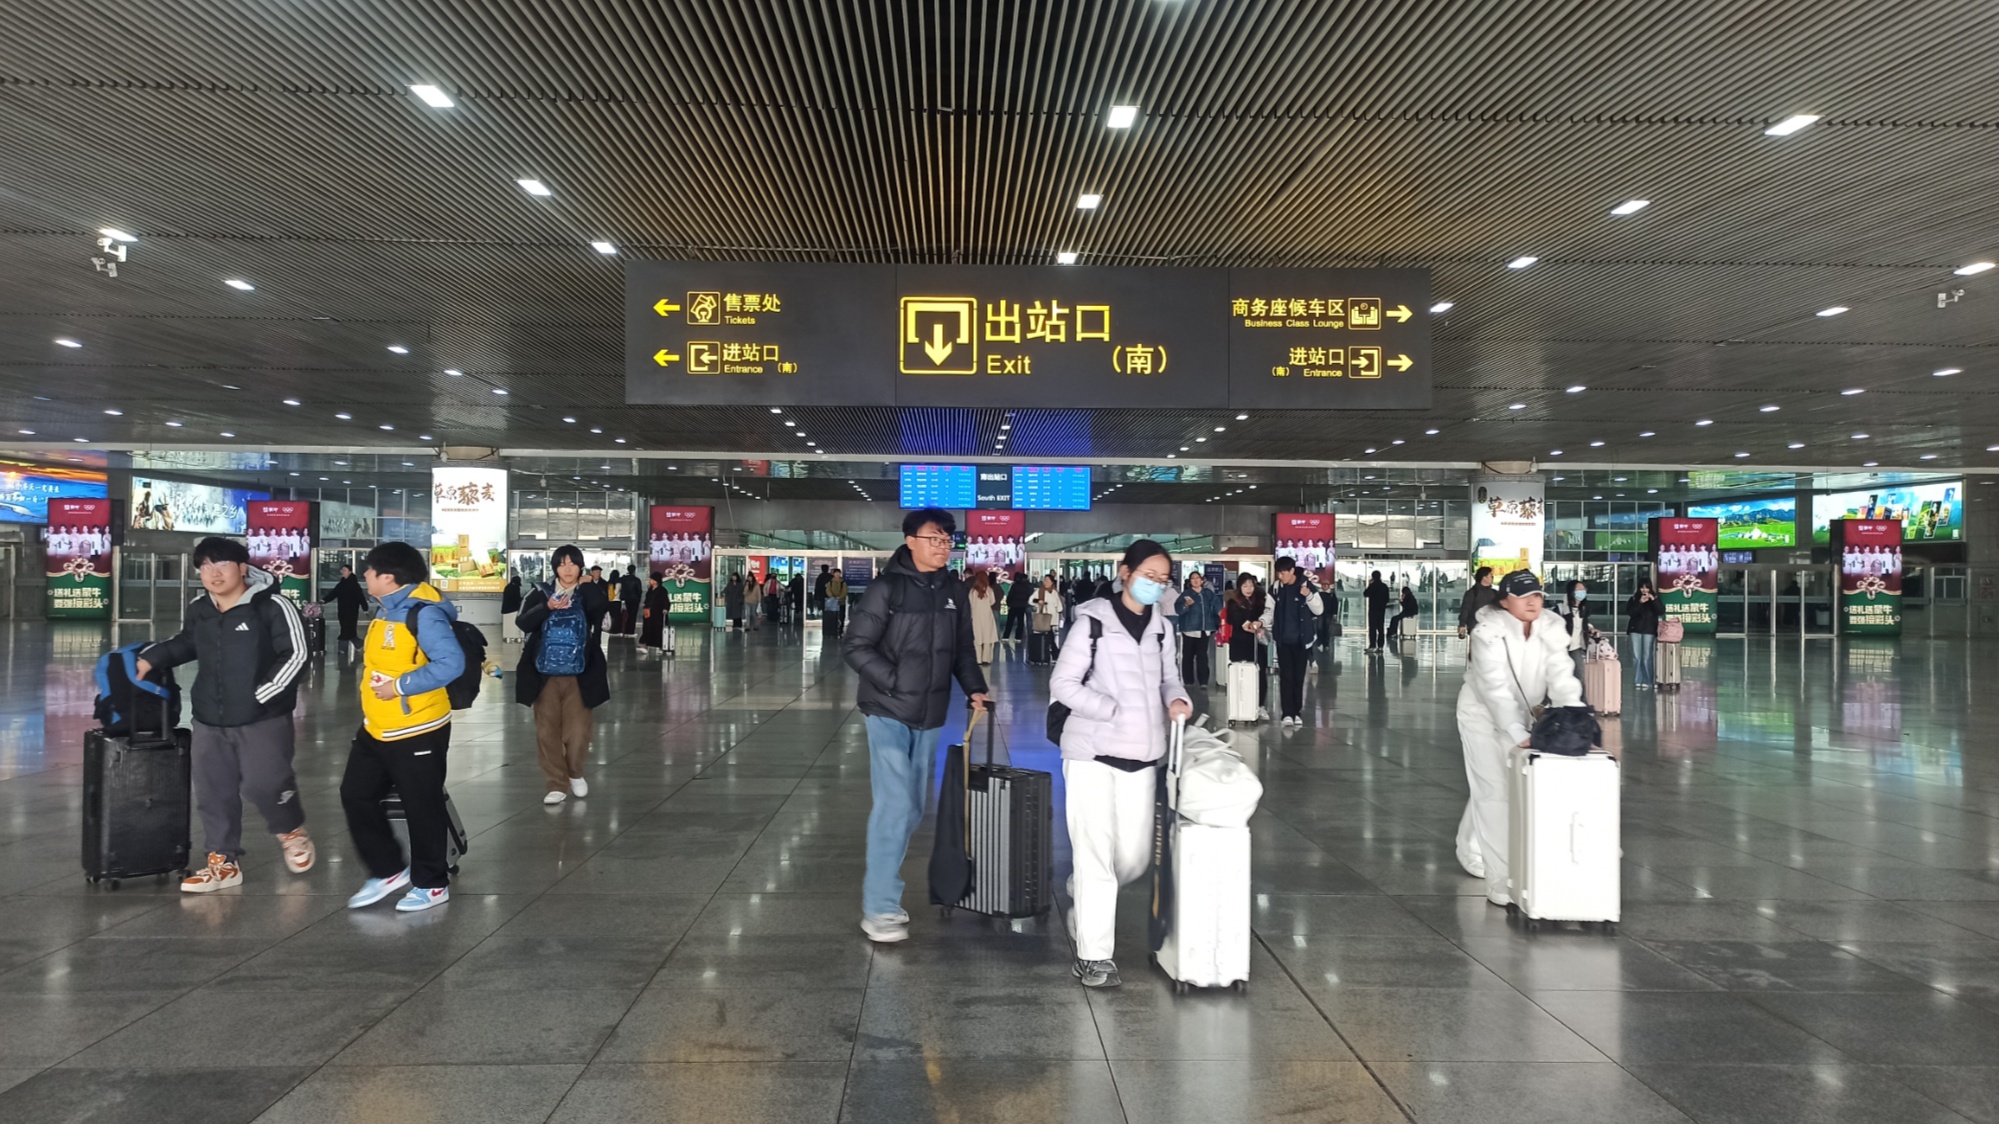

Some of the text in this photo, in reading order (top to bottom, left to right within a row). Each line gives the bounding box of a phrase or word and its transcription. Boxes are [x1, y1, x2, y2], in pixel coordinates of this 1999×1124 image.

[723, 293, 781, 312] 售票处
[1231, 297, 1345, 317] 商务座候车区
[724, 316, 756, 325] Tickets
[985, 299, 1110, 343] 出站口
[1244, 319, 1344, 329] Business Class Lounge
[722, 343, 779, 362] 进站口
[1289, 347, 1344, 366] 进站口
[724, 364, 763, 374] Entrance
[987, 355, 1031, 374] Exit
[1303, 368, 1343, 377] Entrance
